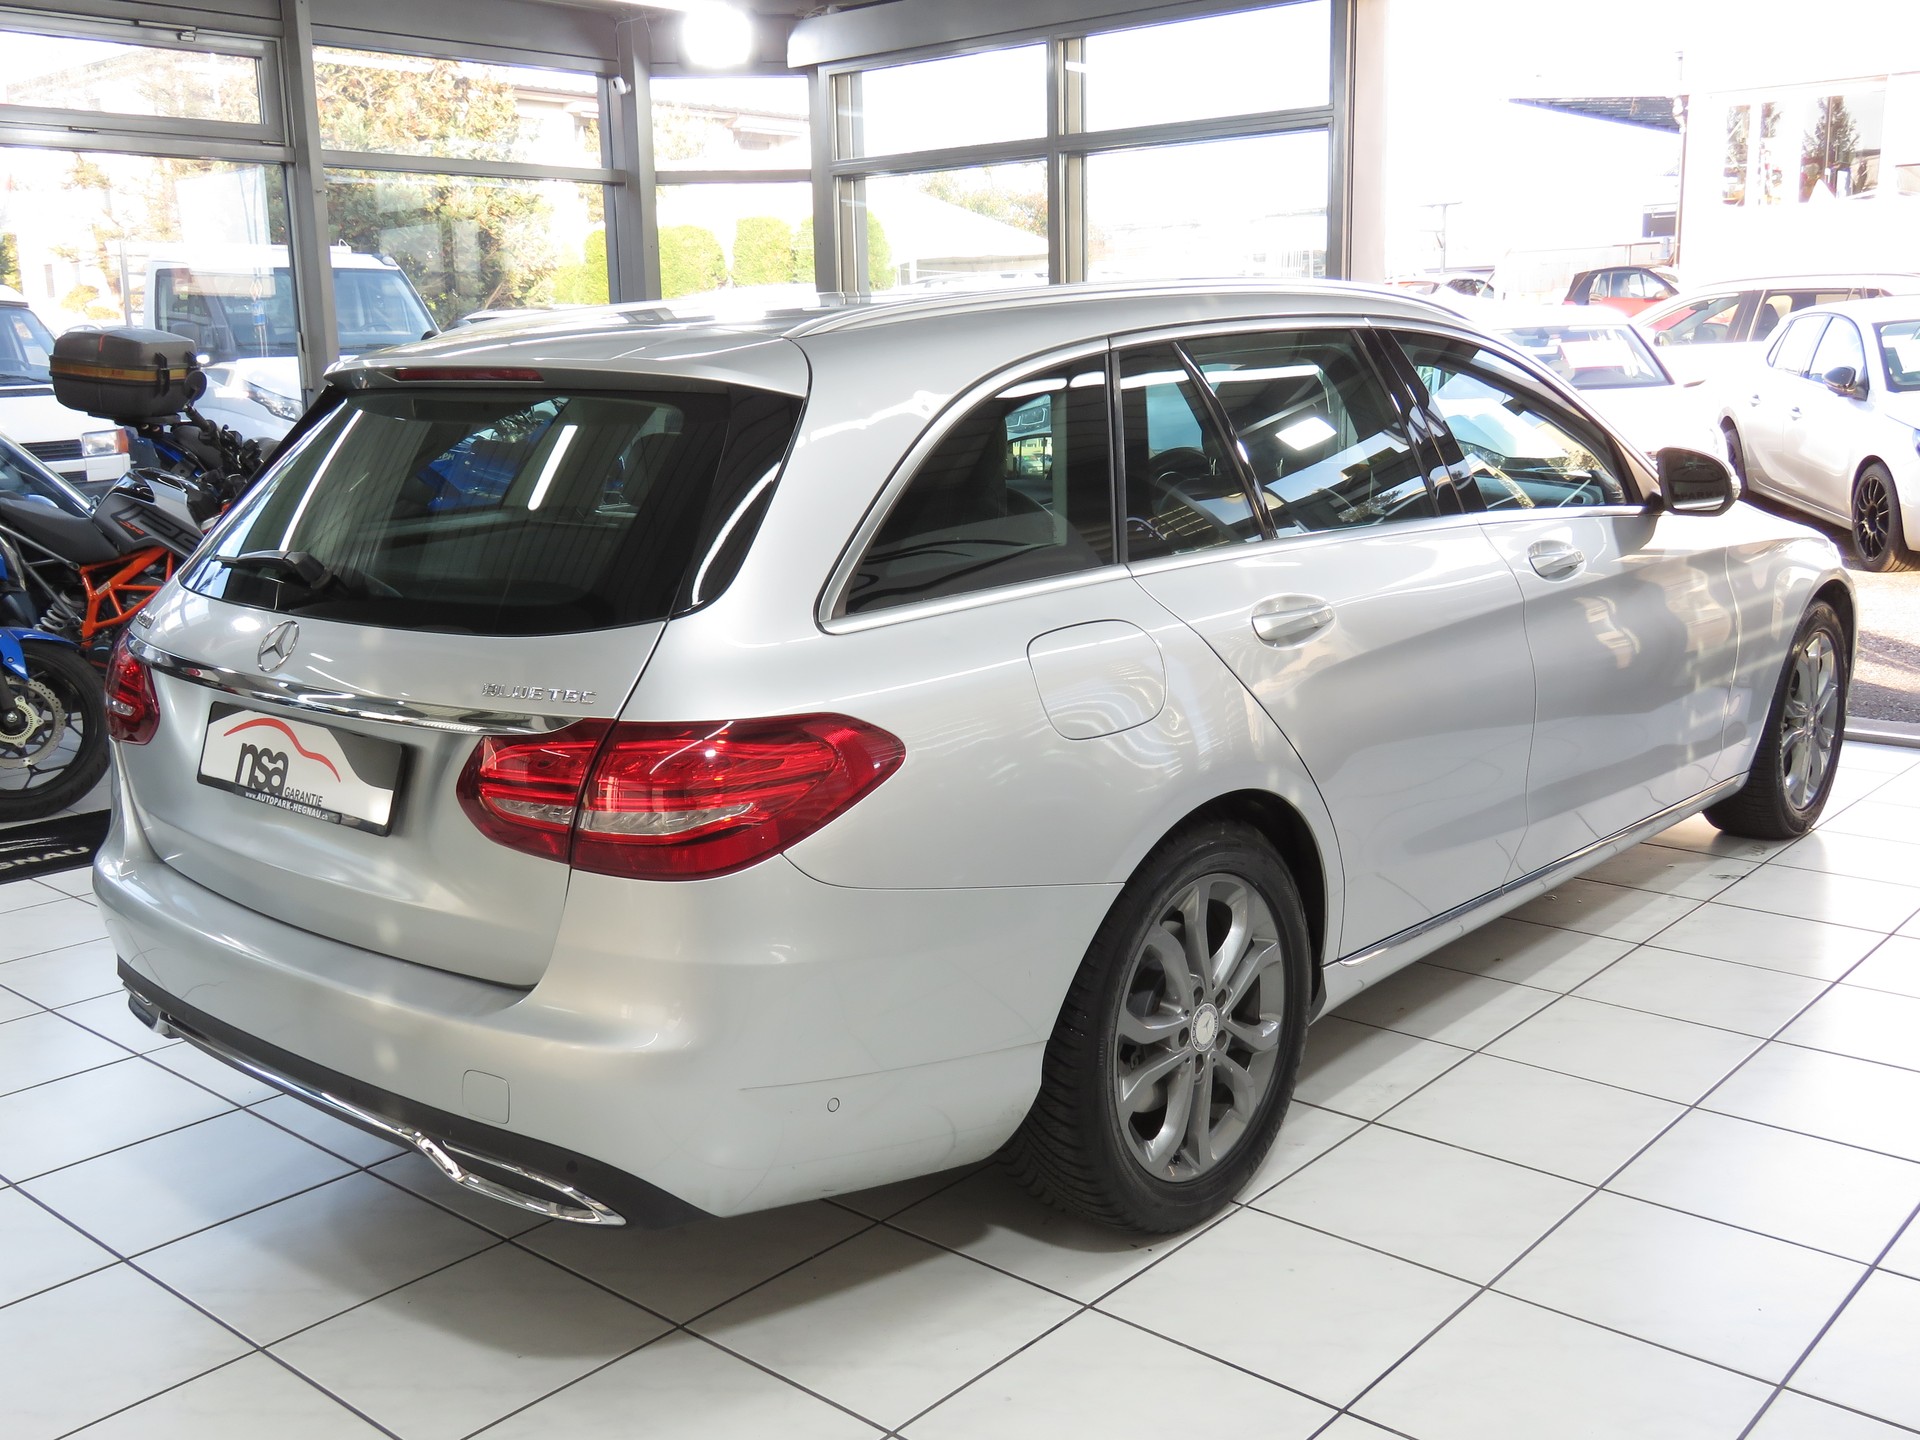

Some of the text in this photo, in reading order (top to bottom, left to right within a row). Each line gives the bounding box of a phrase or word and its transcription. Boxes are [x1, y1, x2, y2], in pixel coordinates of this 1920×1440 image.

[482, 682, 597, 704] BLUETEC
[235, 743, 289, 796] nsa
[245, 791, 329, 820] www.AUTOPARK-HEGNAU.ch
[284, 786, 323, 807] GARANTIE
